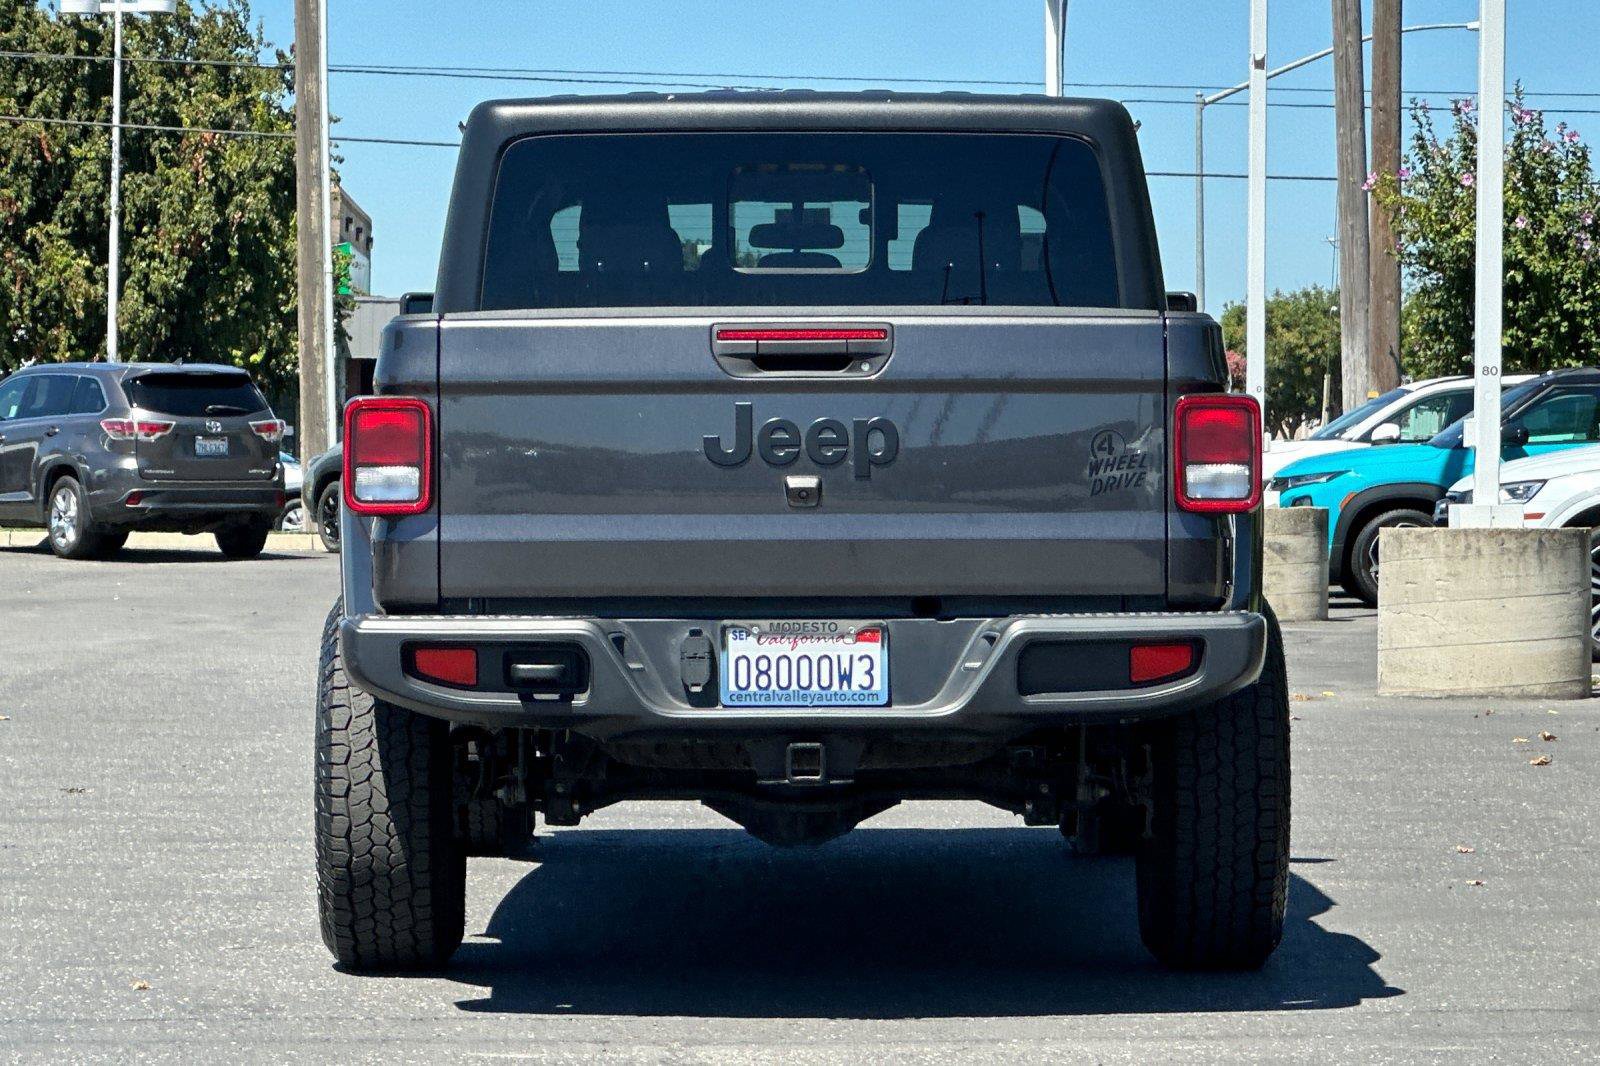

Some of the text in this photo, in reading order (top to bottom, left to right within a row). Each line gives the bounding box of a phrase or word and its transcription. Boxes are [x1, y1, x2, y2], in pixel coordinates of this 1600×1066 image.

[1482, 365, 1498, 376] 80
[703, 402, 900, 480] Jeep
[1097, 434, 1115, 456] 4
[1088, 453, 1148, 477] WHEEL
[1090, 471, 1147, 496] DRIVE
[769, 621, 838, 633] MODESTO
[734, 654, 875, 691] 08000W3
[729, 689, 879, 705] centralvalleyauto.com
